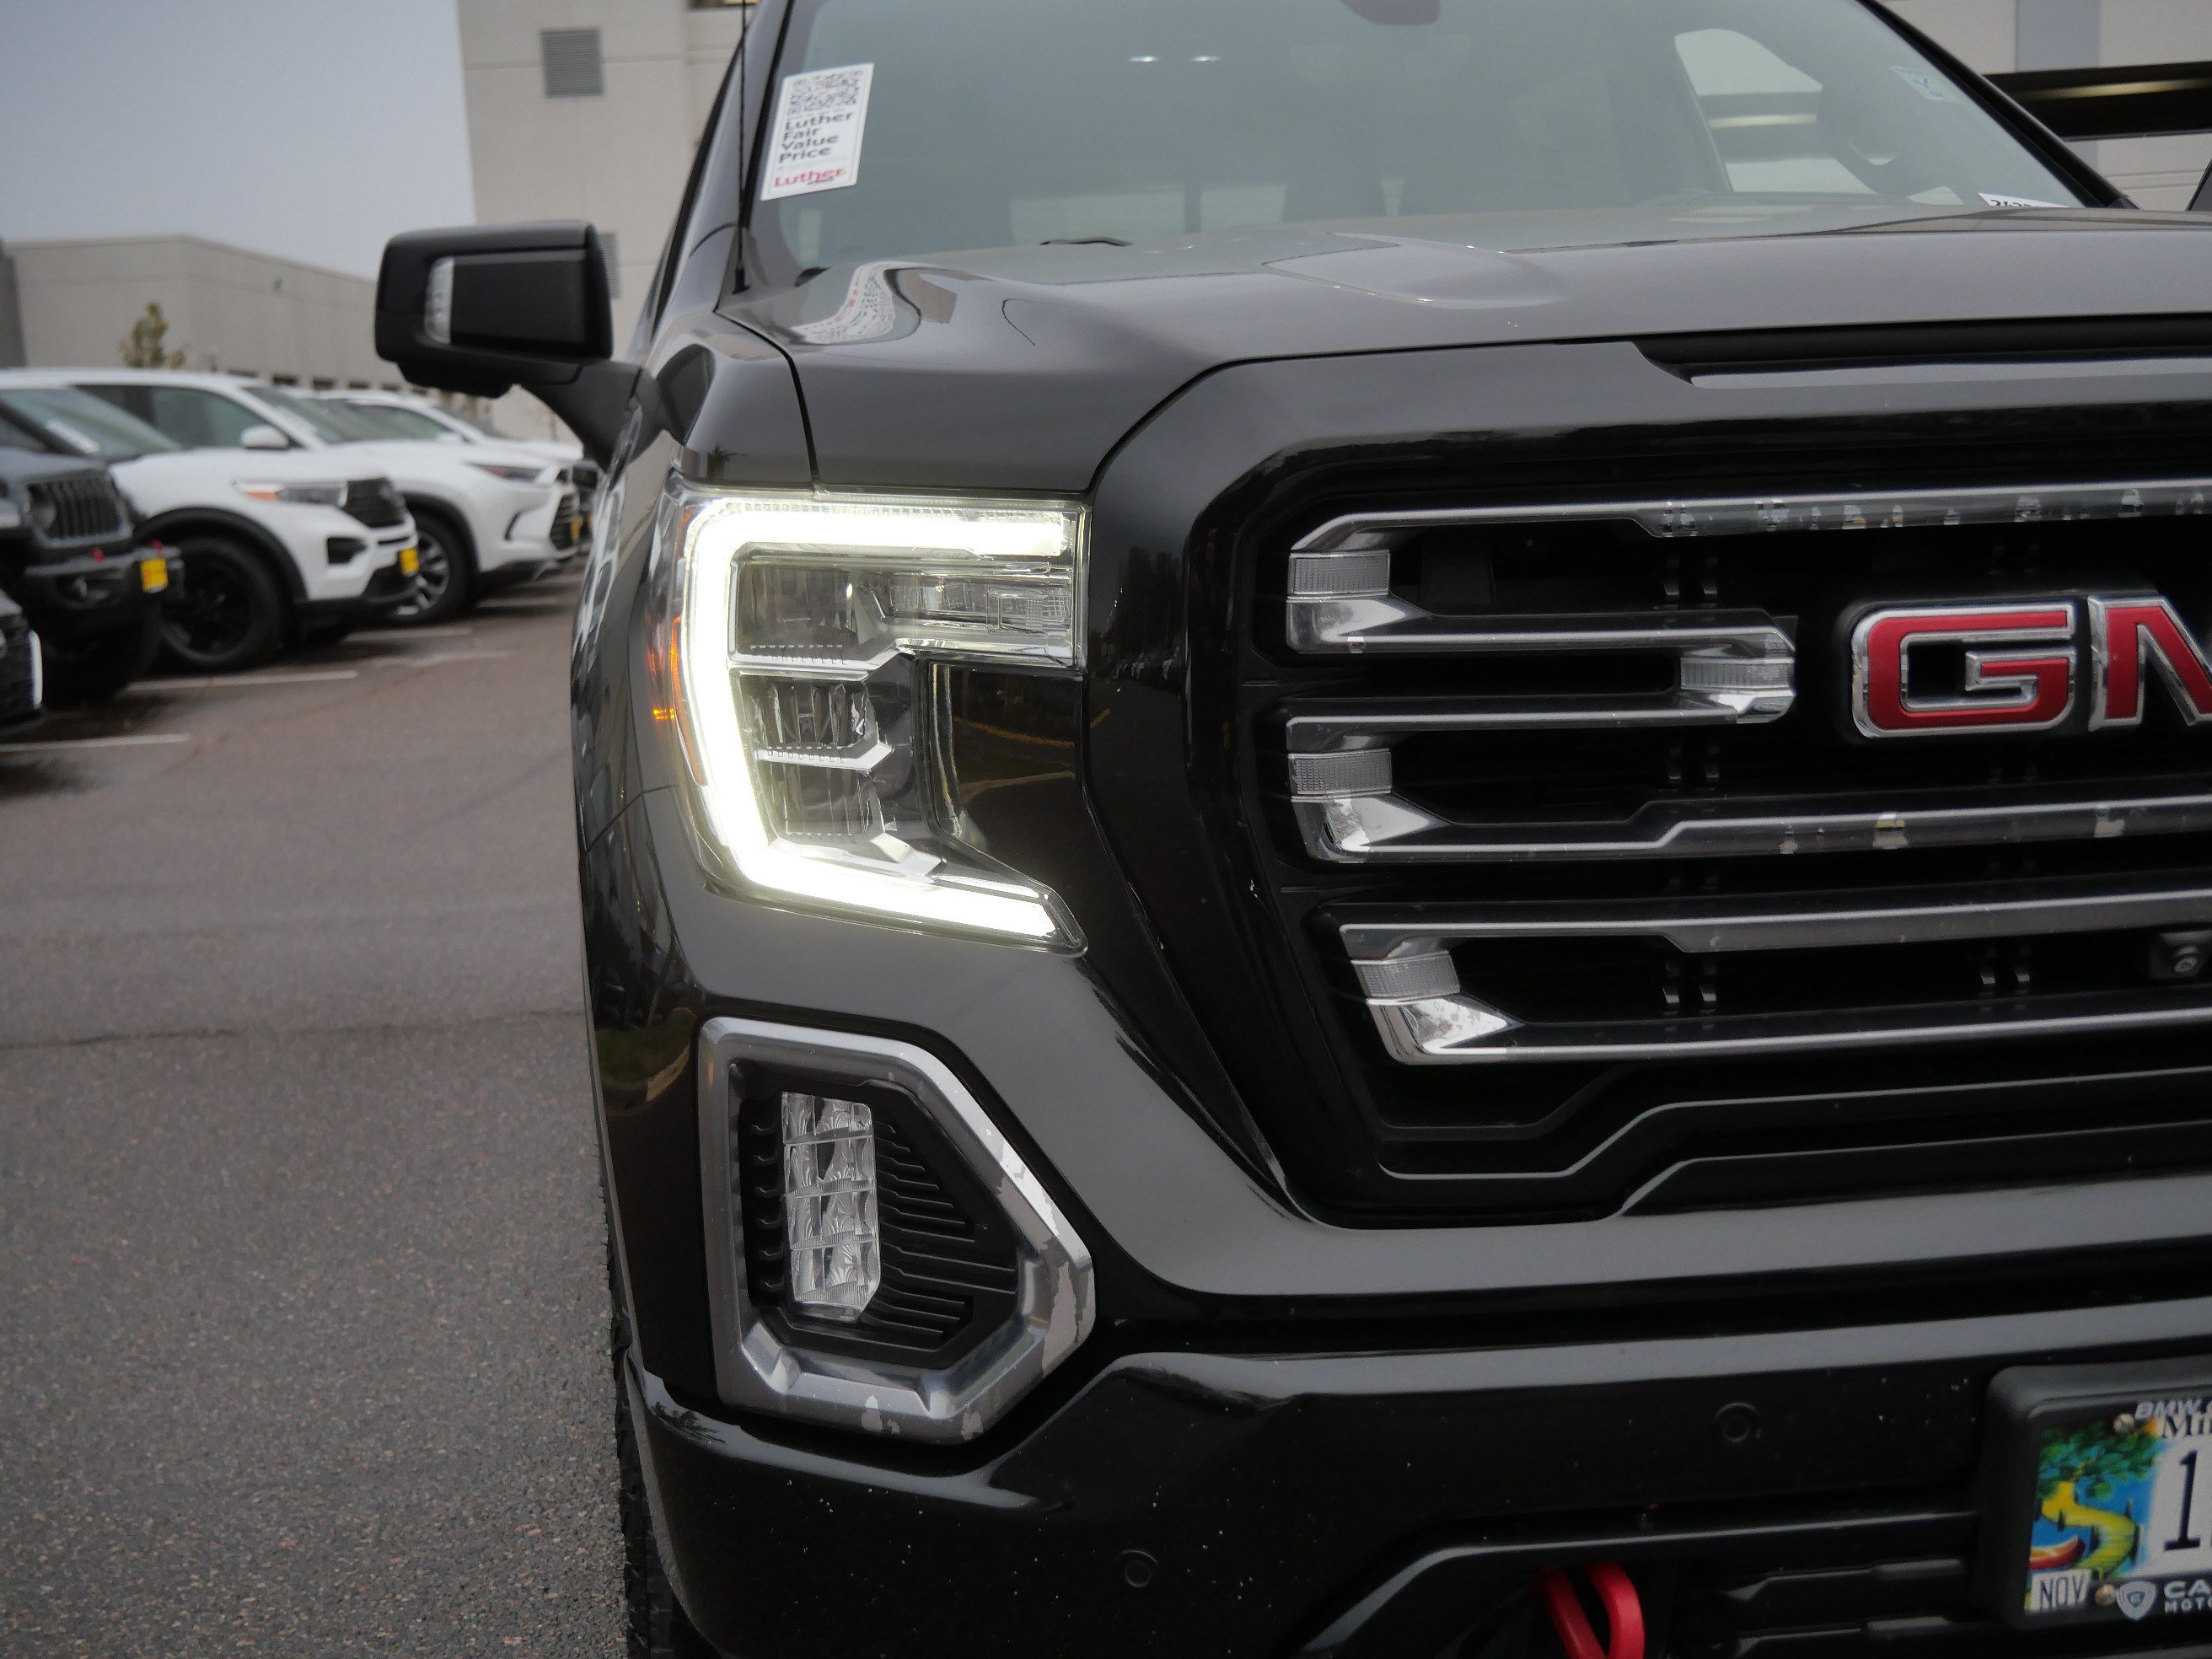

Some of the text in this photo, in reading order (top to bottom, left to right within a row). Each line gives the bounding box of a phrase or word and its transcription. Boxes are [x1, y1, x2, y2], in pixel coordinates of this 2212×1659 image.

[785, 112, 854, 131] Luther
[781, 135, 839, 151] Value
[783, 127, 820, 141] Fair
[779, 147, 831, 163] Price
[774, 168, 846, 187] Luther
[2163, 1449, 2212, 1551] 1
[2040, 1573, 2086, 1611] NOV
[2164, 1579, 2212, 1598] CA
